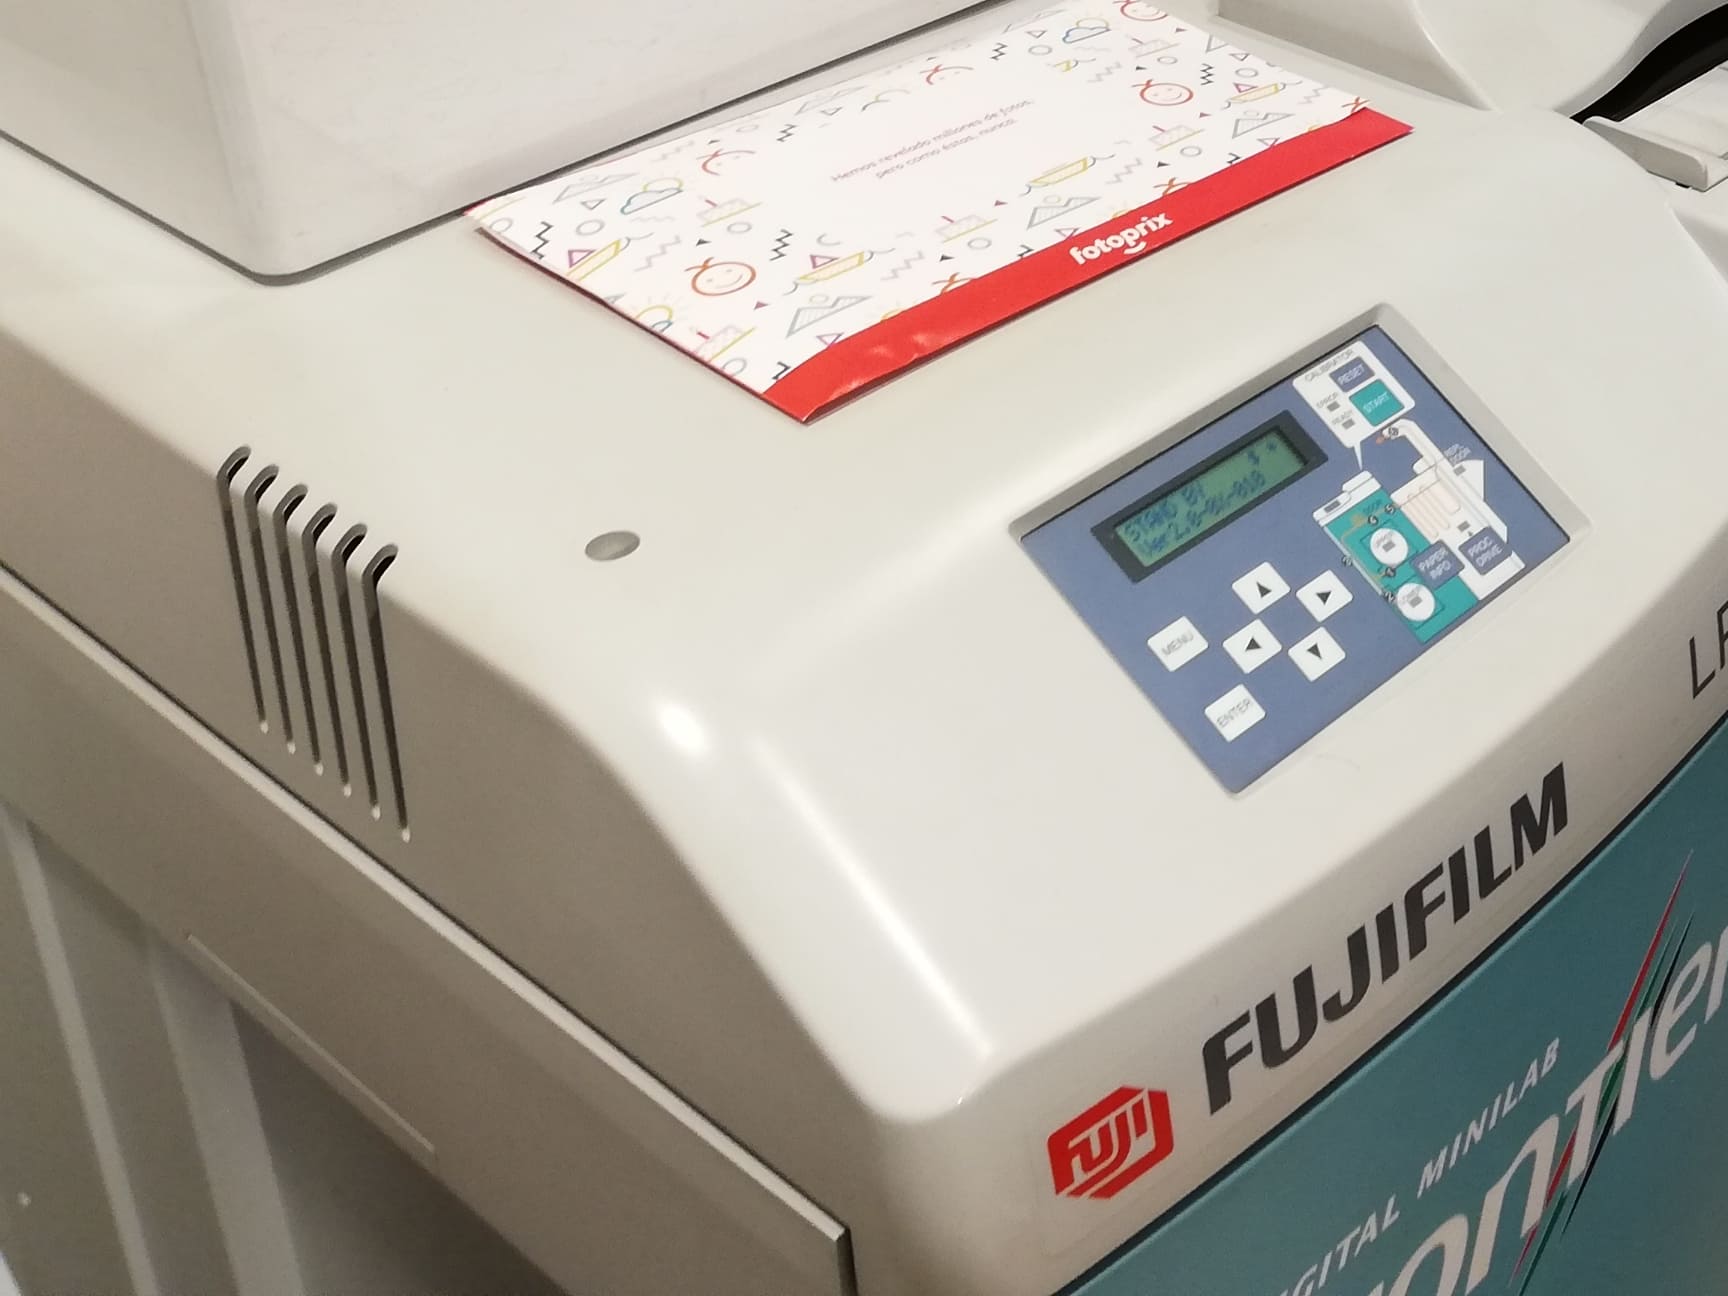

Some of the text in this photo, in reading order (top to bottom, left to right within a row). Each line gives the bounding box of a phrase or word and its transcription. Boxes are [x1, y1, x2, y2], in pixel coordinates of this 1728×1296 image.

[1068, 212, 1174, 265] fotoprix
[1336, 364, 1366, 385] RESET
[1362, 391, 1391, 414] START
[1201, 761, 1569, 1117] FUJIFILM
[1416, 1037, 1560, 1199] MINILAB
